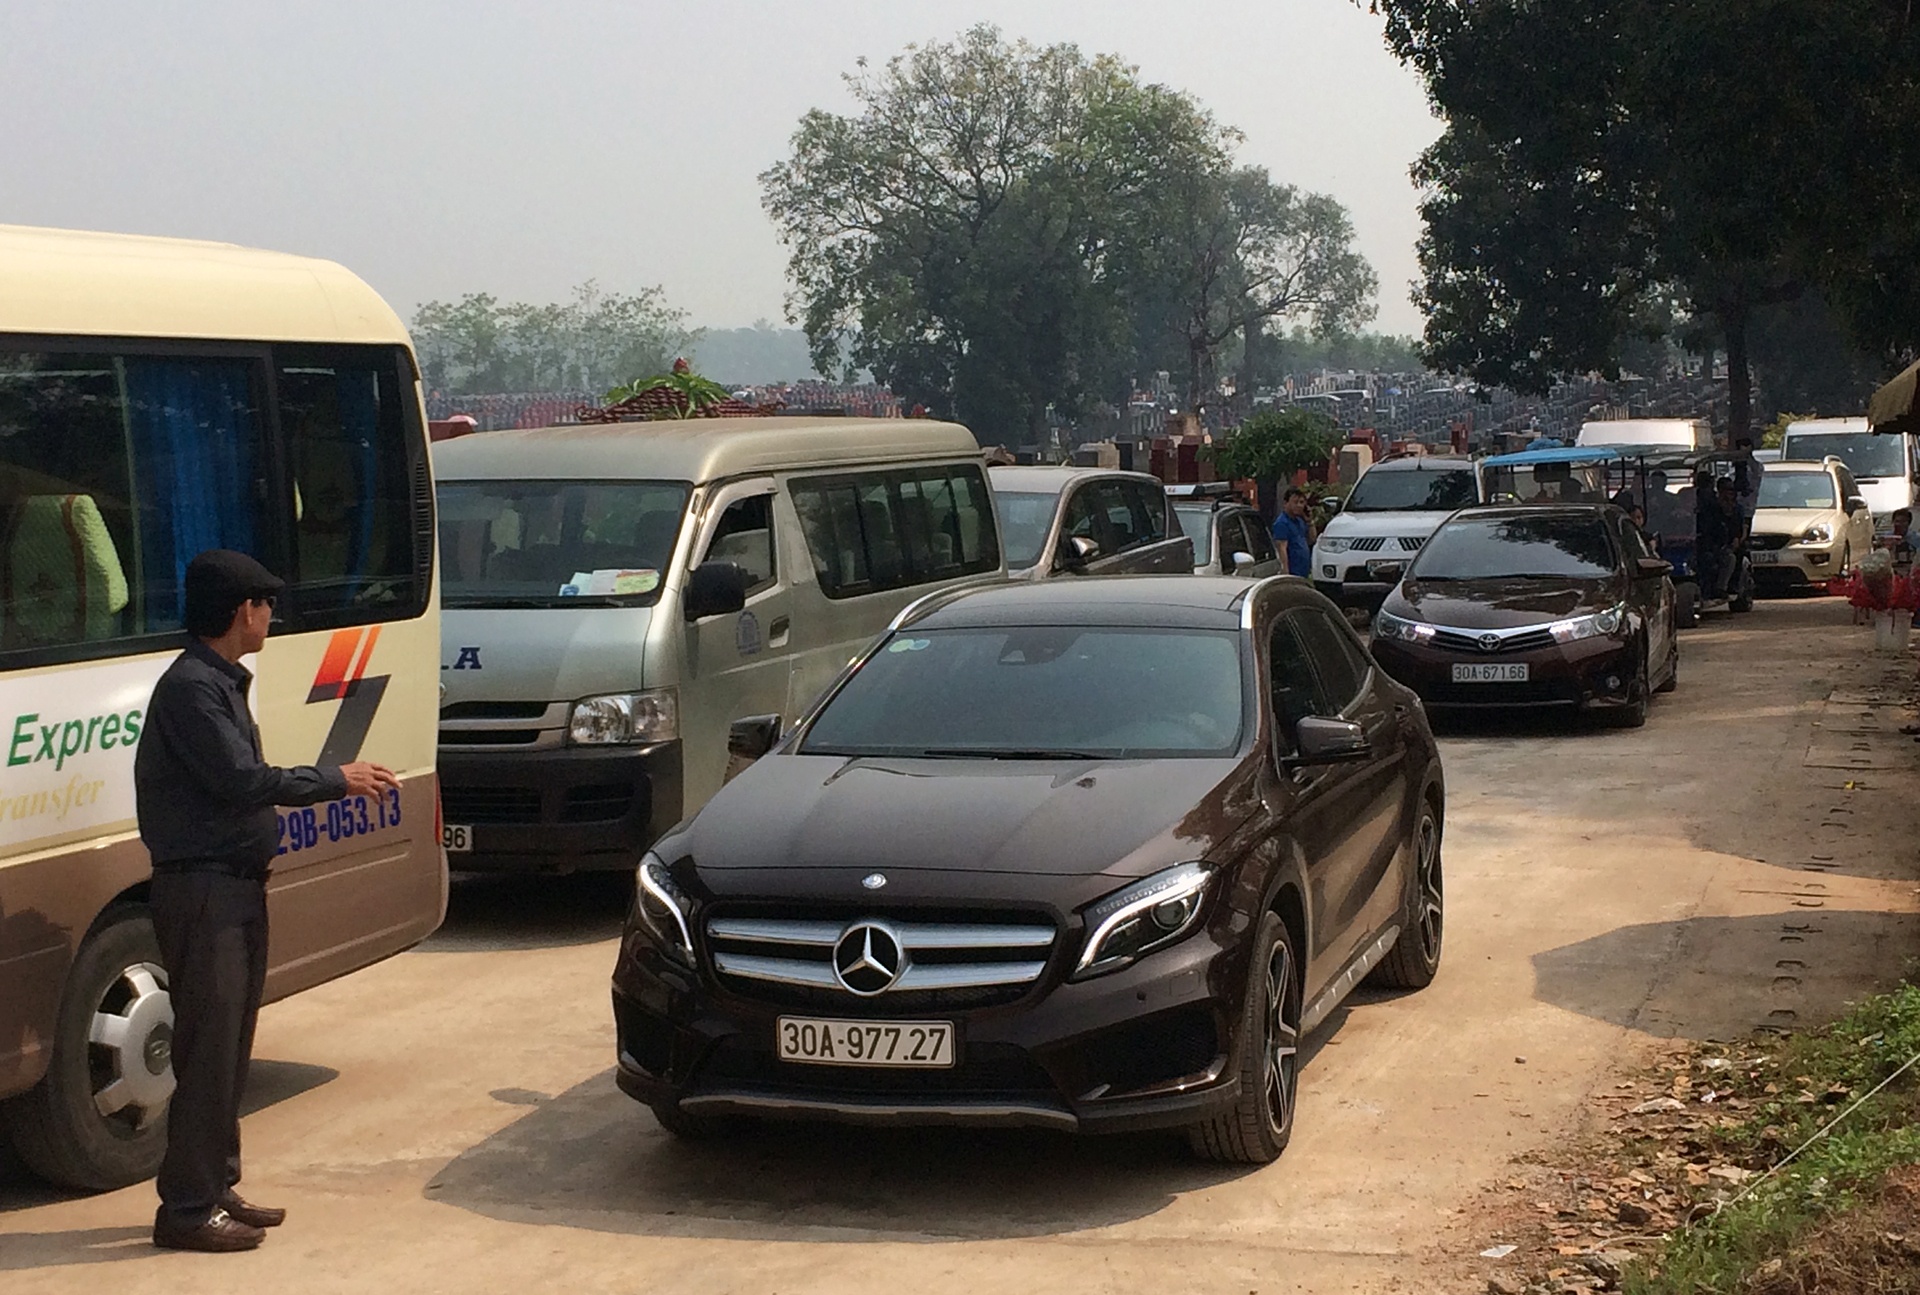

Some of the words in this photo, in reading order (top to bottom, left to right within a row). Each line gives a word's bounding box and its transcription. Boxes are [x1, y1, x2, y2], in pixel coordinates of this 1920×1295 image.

[1454, 666, 1525, 680] 30A-671.66
[0, 773, 105, 822] ransfer
[784, 1022, 946, 1061] 30A-977.27
